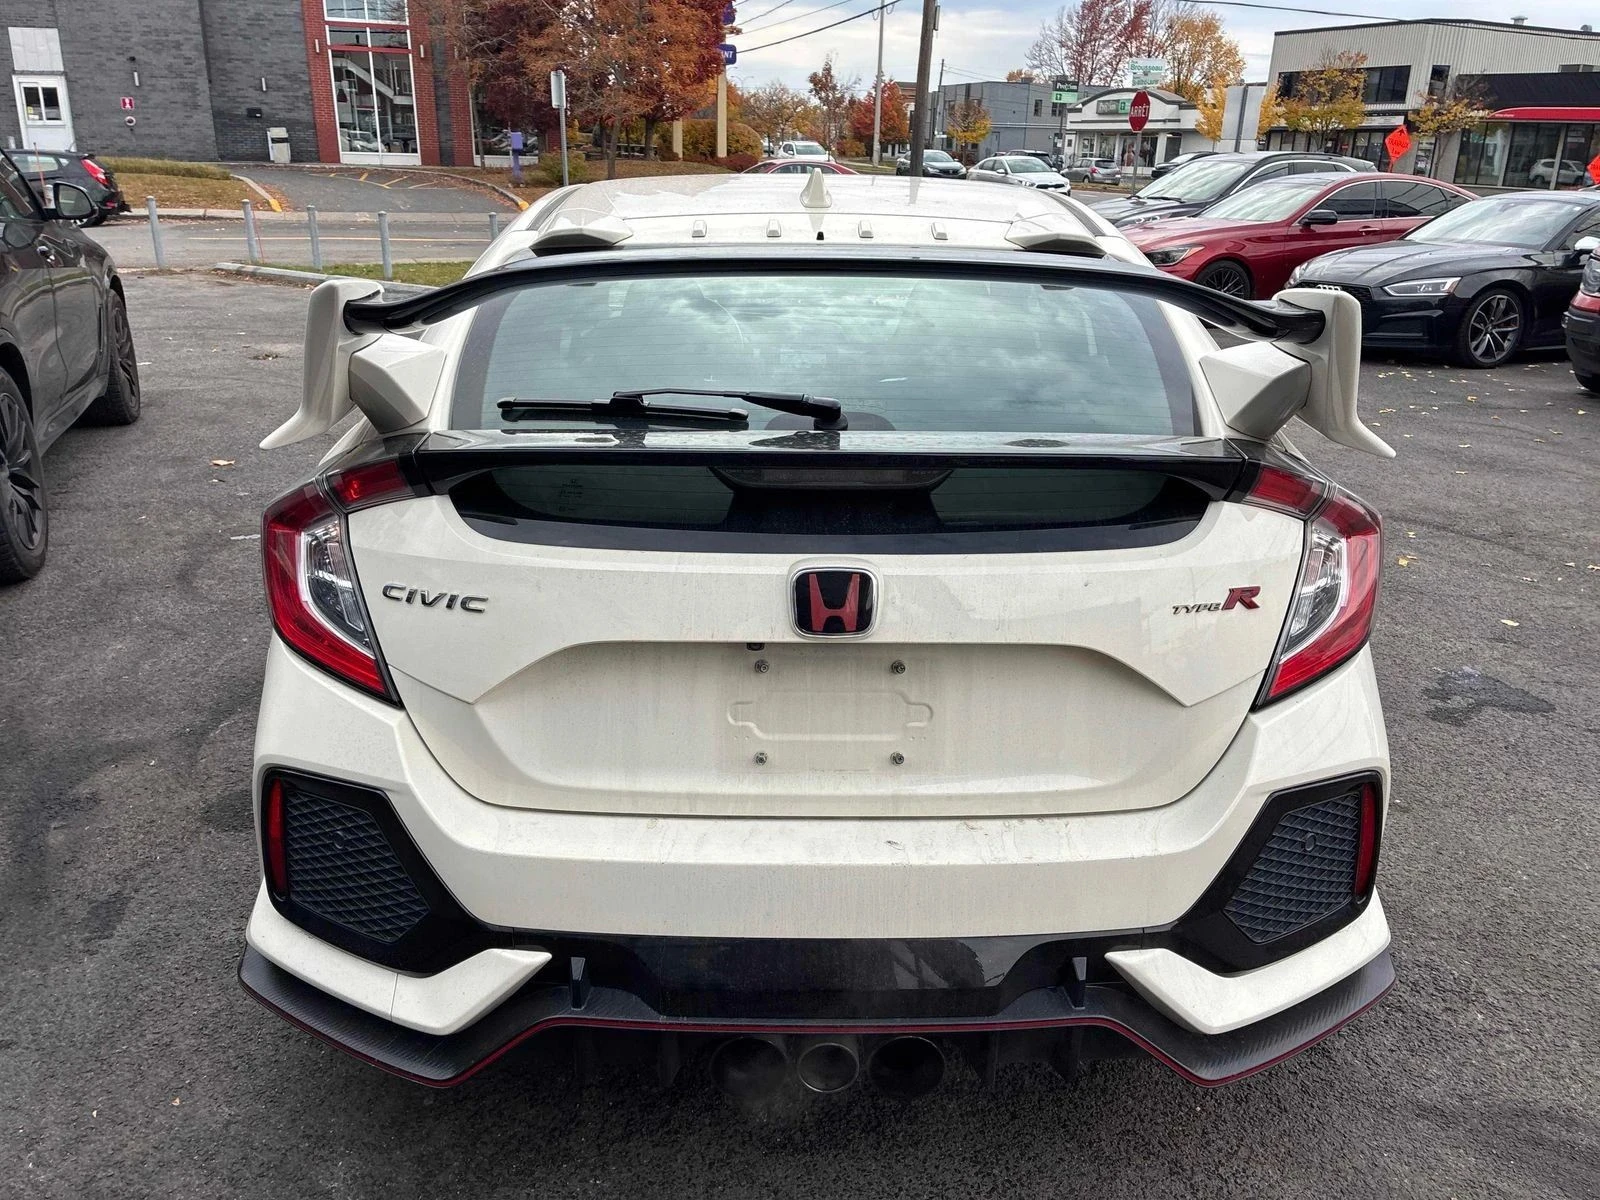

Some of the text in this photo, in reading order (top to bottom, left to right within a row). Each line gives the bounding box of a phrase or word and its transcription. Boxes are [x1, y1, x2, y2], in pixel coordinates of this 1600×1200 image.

[1130, 63, 1163, 72] Brousseau
[1130, 103, 1150, 117] ARRÊT
[382, 582, 489, 614] CIVIC
[1172, 585, 1262, 615] TYPE R
